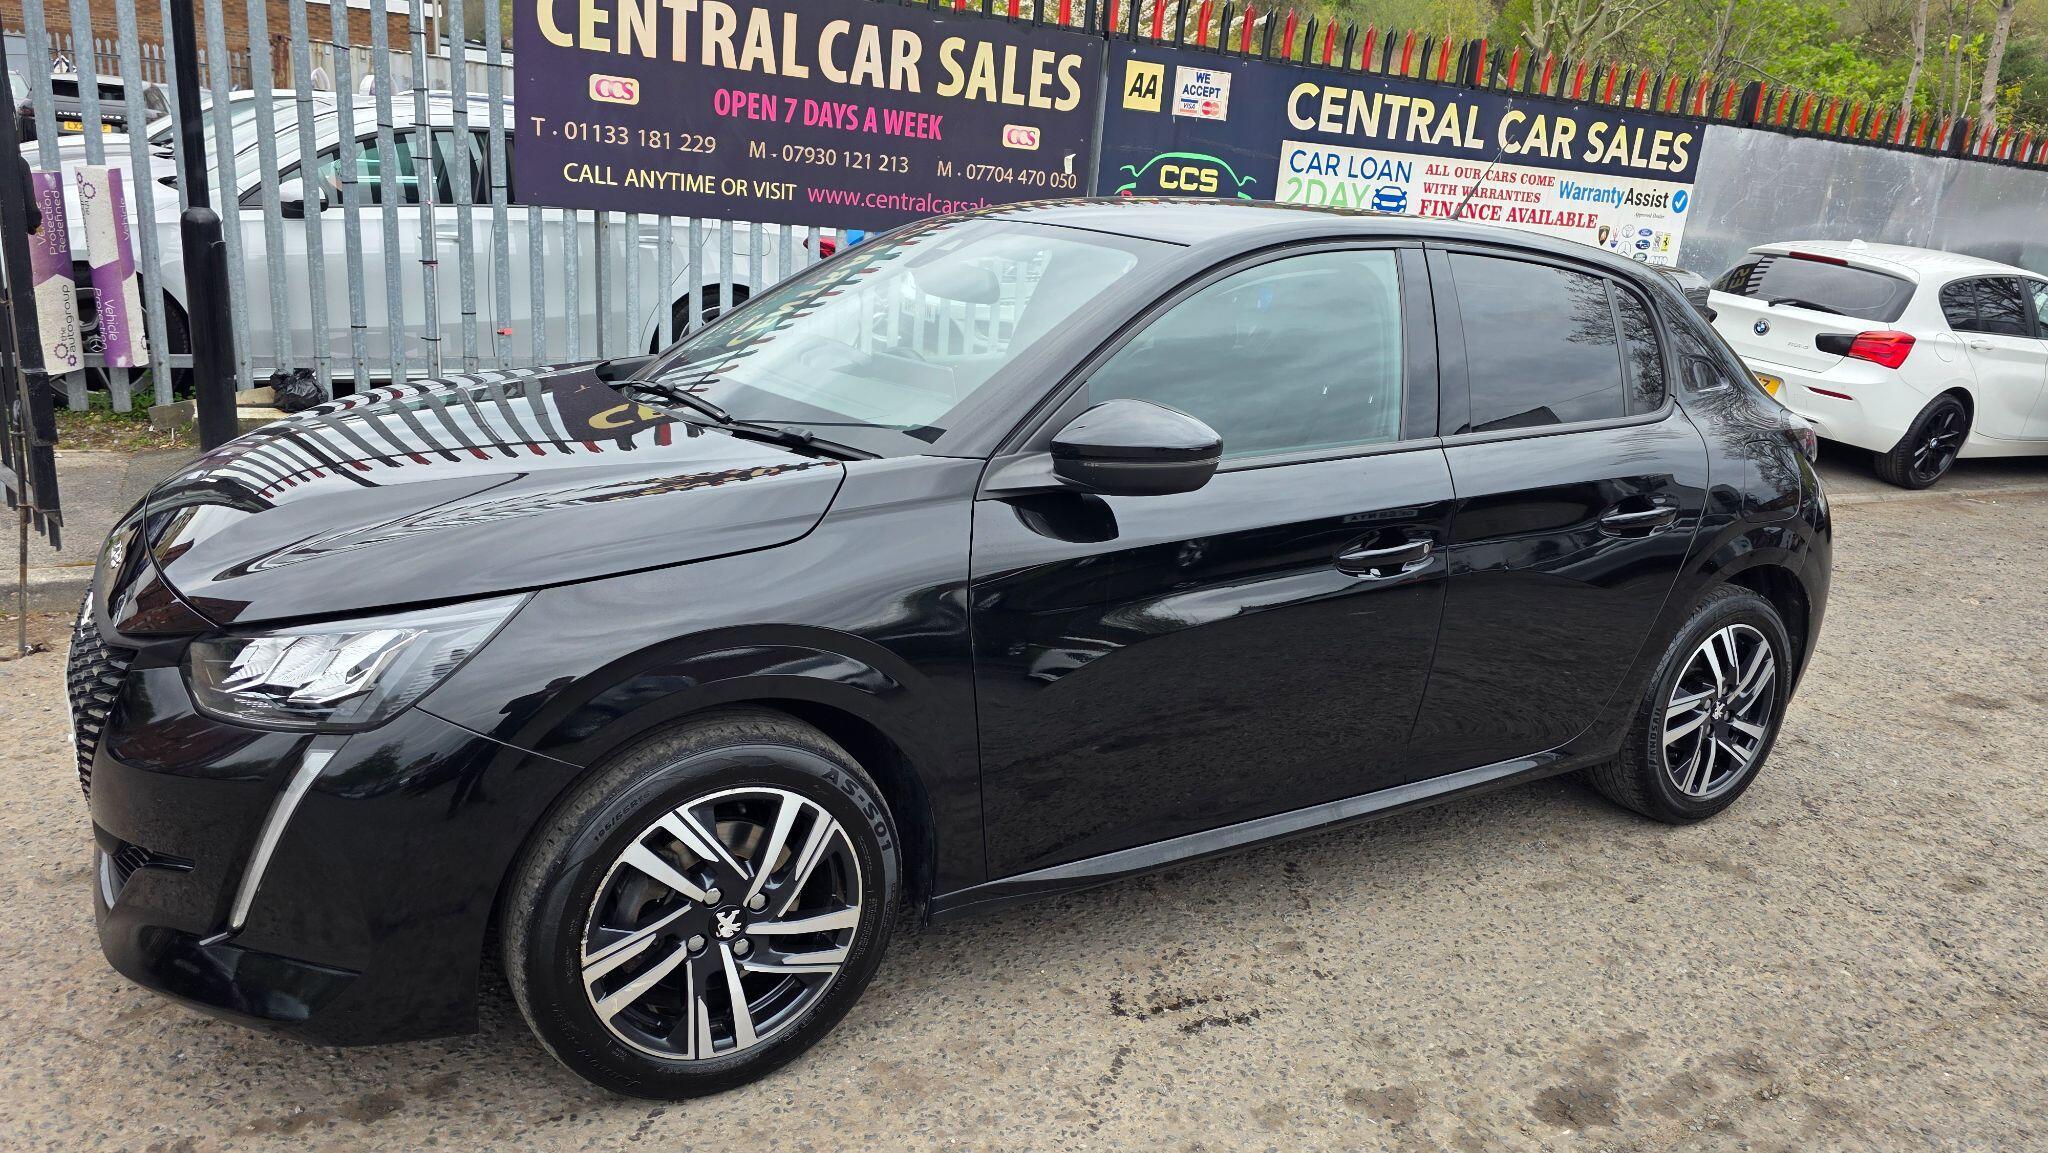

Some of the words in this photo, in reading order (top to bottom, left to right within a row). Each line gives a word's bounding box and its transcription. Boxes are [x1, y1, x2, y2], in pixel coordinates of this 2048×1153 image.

[536, 0, 809, 79] CENTRAL
[818, 19, 921, 93] CAR
[936, 37, 1083, 112] SALES
[1128, 72, 1158, 100] AA
[1182, 84, 1222, 98] ACCEPT
[1196, 72, 1211, 84] WE
[714, 88, 777, 123] OPEN
[784, 98, 798, 124] 7
[804, 100, 858, 131] DAYS
[863, 107, 878, 133] A
[883, 109, 943, 141] WEEK
[1287, 82, 1484, 150] CENTRAL
[1498, 110, 1577, 160] CAR
[1583, 121, 1693, 173] SALES
[531, 116, 546, 137] T
[564, 121, 630, 146] 01133
[638, 129, 671, 150] 181
[680, 133, 717, 154] 229
[749, 140, 766, 160] M
[782, 144, 837, 167] 07930
[843, 151, 871, 170] 121
[878, 154, 909, 173] 213
[1289, 149, 1341, 177] CAR
[1347, 155, 1413, 184] LOAN
[563, 162, 618, 186] CALL
[624, 168, 716, 195] ANYTIME
[721, 178, 748, 197] OR
[753, 180, 798, 201] VISIT
[936, 160, 952, 178] M
[966, 163, 1014, 184] 07704
[1017, 169, 1046, 187] 470
[1050, 172, 1077, 190] 050
[1159, 164, 1219, 193] CCS
[1425, 163, 1450, 177] ALL
[1454, 166, 1482, 180] OUR
[1485, 169, 1517, 184] CARS
[1520, 173, 1556, 188] COME
[1285, 176, 1371, 210] 2DAY
[1423, 182, 1457, 196] WITH
[1461, 185, 1541, 204] WARRANTIES
[44, 189, 58, 255] Protection
[51, 190, 67, 253] Redefined
[1418, 199, 1502, 220] FINANCE
[1505, 206, 1599, 230] AVAILABLE
[62, 284, 77, 353] autogroup
[104, 299, 120, 341] Vehicle
